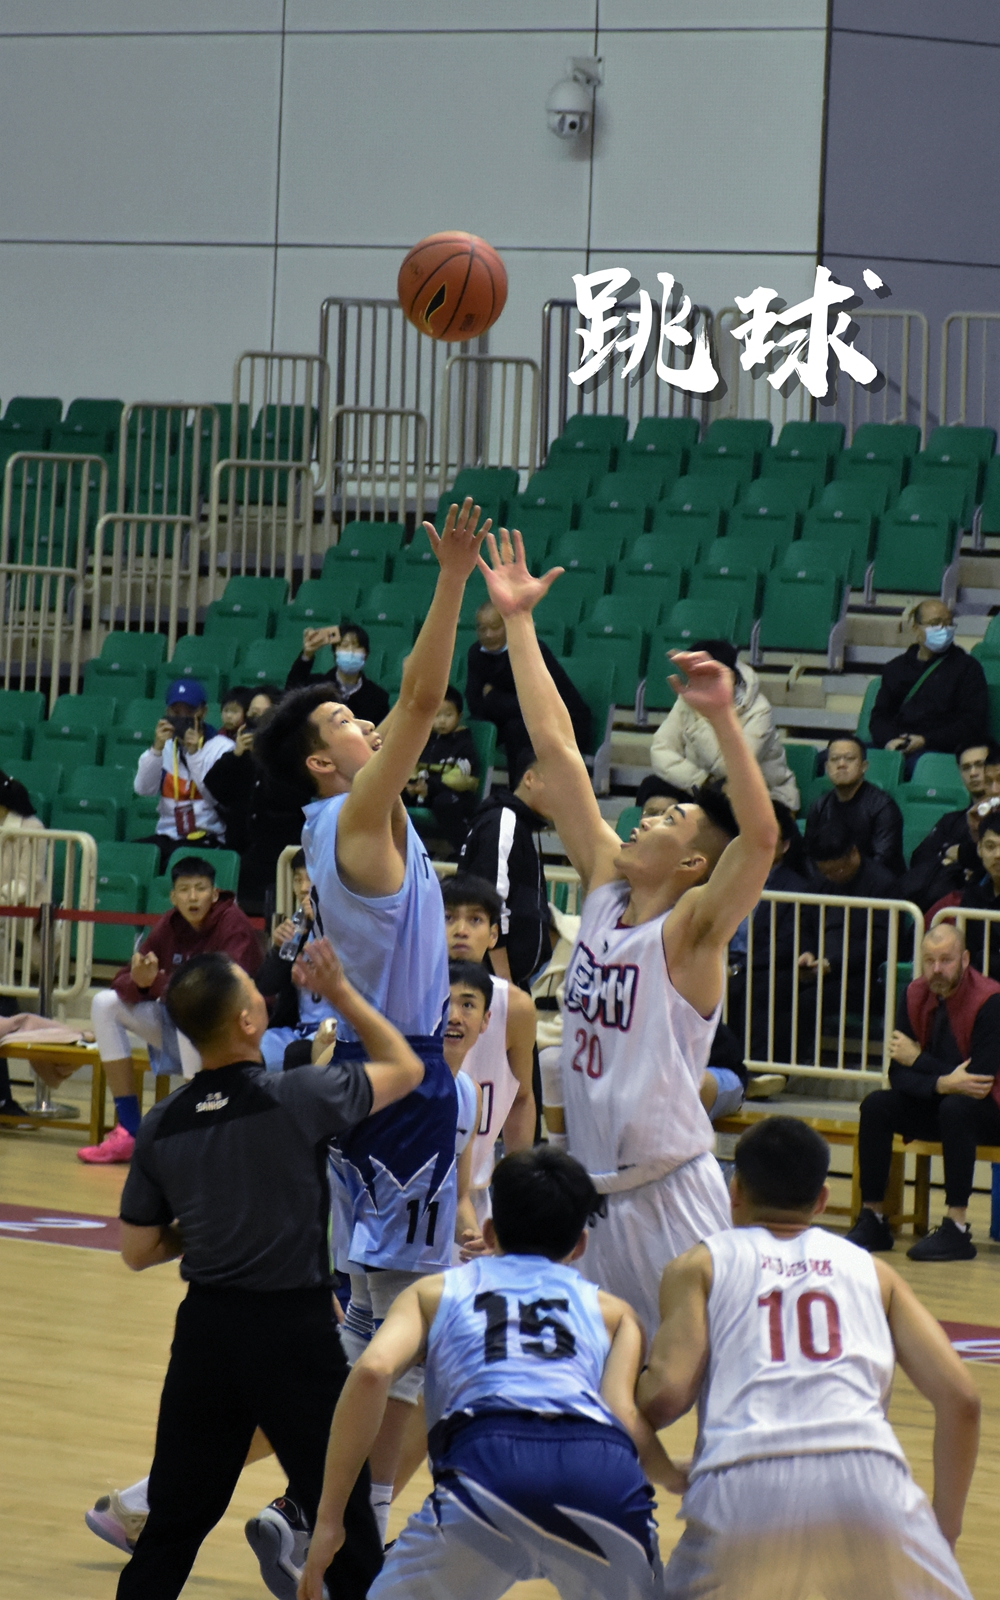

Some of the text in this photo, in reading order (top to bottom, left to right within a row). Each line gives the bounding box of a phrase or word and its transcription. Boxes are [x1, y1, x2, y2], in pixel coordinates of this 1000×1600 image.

[572, 1028, 603, 1079] 20
[406, 1199, 440, 1247] 11
[473, 1291, 577, 1364] 15
[758, 1289, 842, 1362] 10
